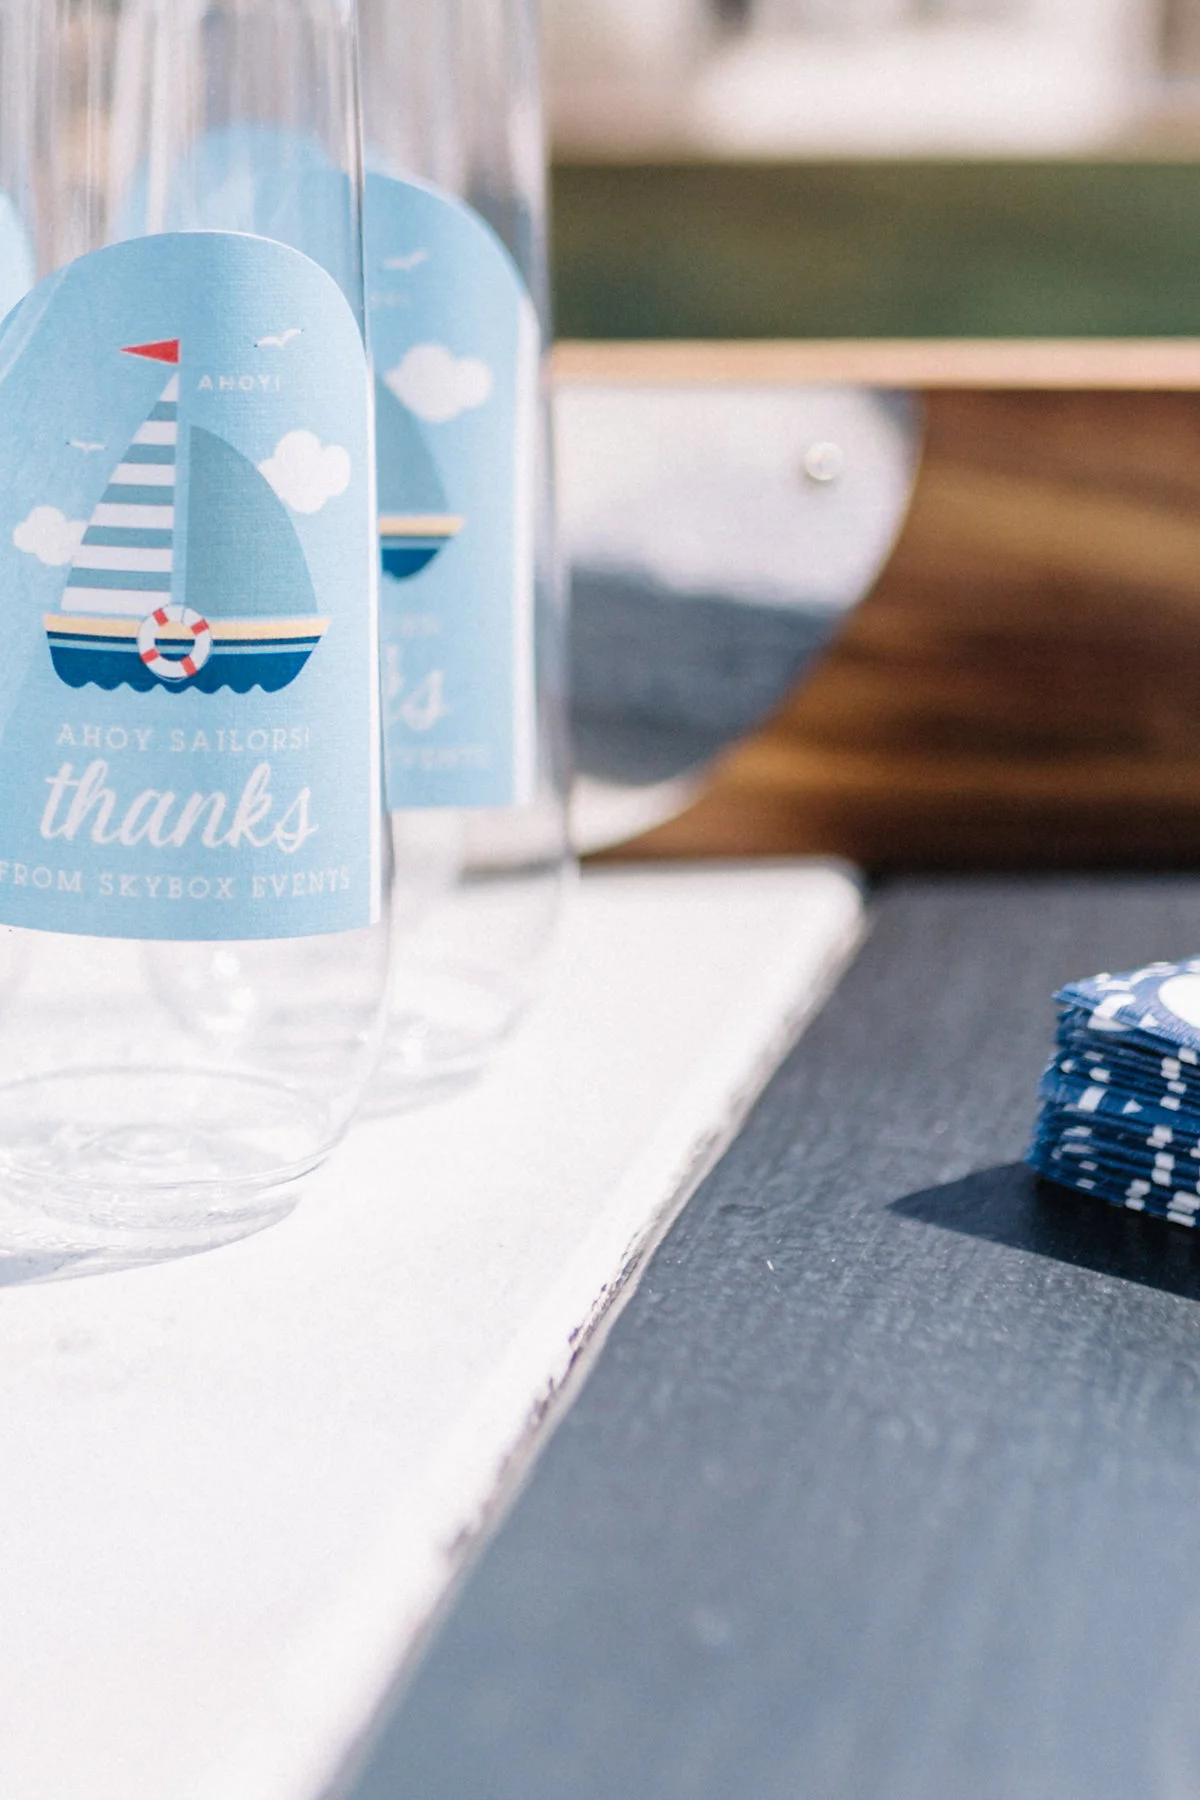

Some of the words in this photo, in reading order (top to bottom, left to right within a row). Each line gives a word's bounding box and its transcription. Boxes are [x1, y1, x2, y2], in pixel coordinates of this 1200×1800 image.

[196, 373, 280, 392] AHOY!
[56, 723, 154, 751] AHOY
[171, 725, 310, 752] SAILORS!
[39, 758, 320, 854] thanks
[98, 871, 235, 900] SKYBOX
[252, 866, 351, 899] EVENTS
